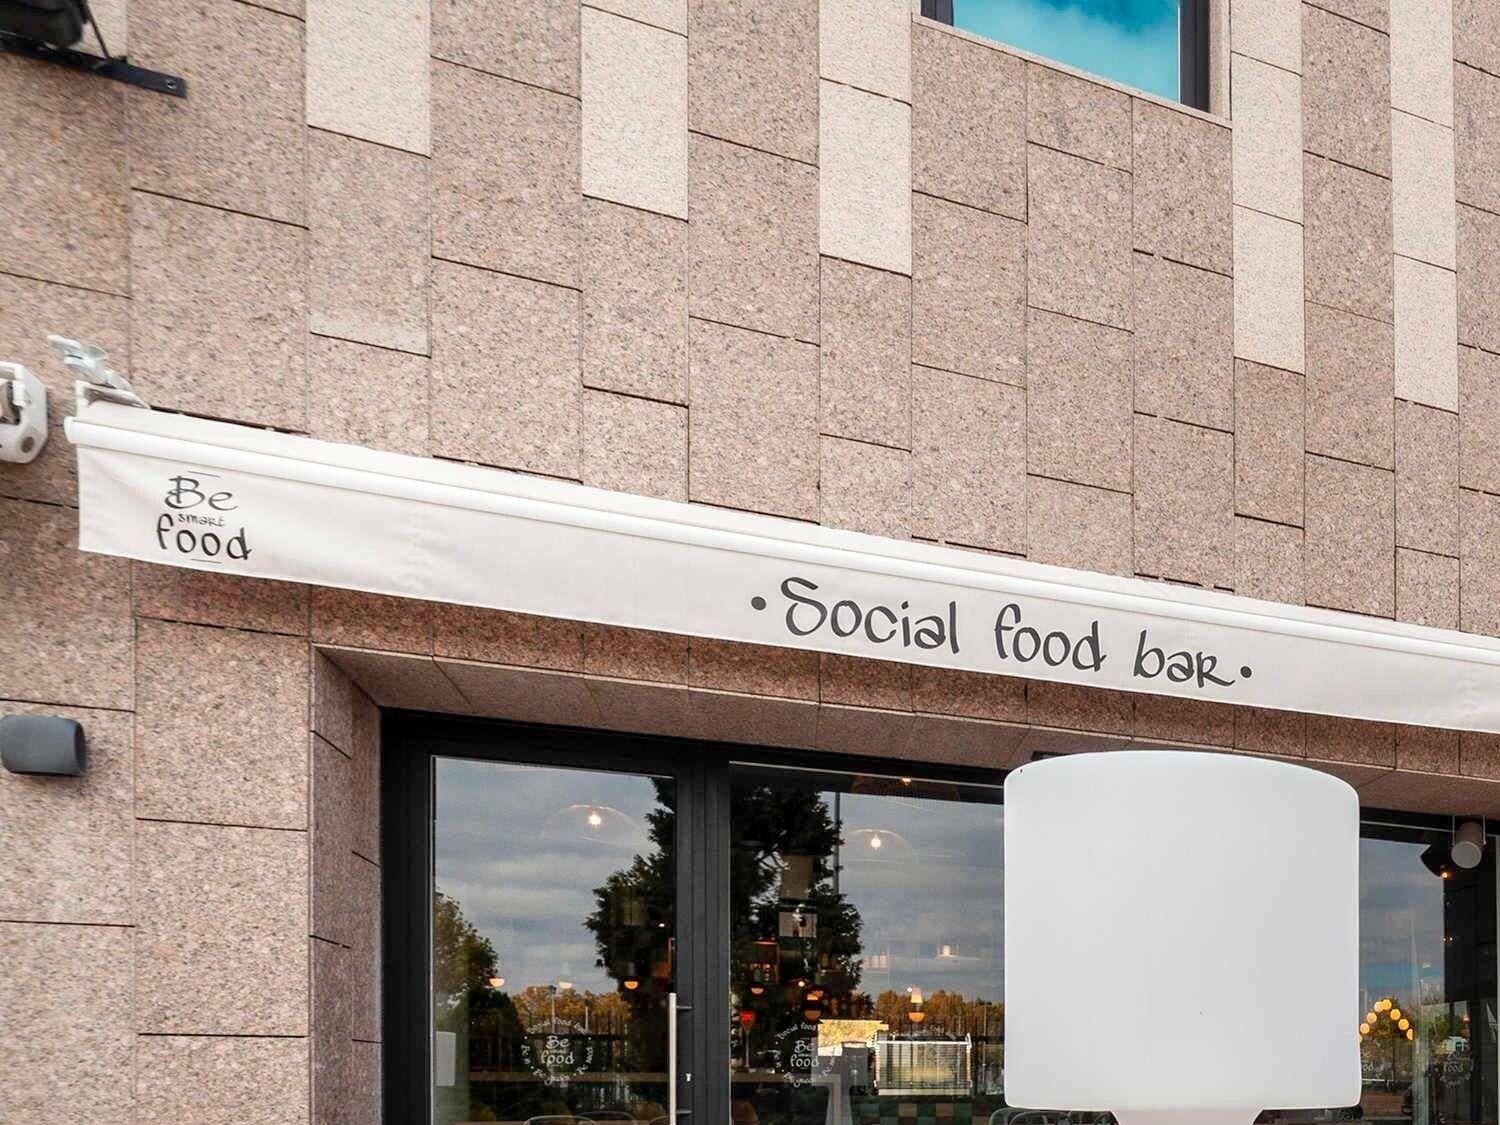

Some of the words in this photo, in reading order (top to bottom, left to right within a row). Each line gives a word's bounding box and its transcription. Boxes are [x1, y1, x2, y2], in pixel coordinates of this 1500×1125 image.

[164, 475, 238, 510] Be
[157, 513, 252, 561] food
[780, 575, 959, 654] Social
[994, 602, 1107, 672] food
